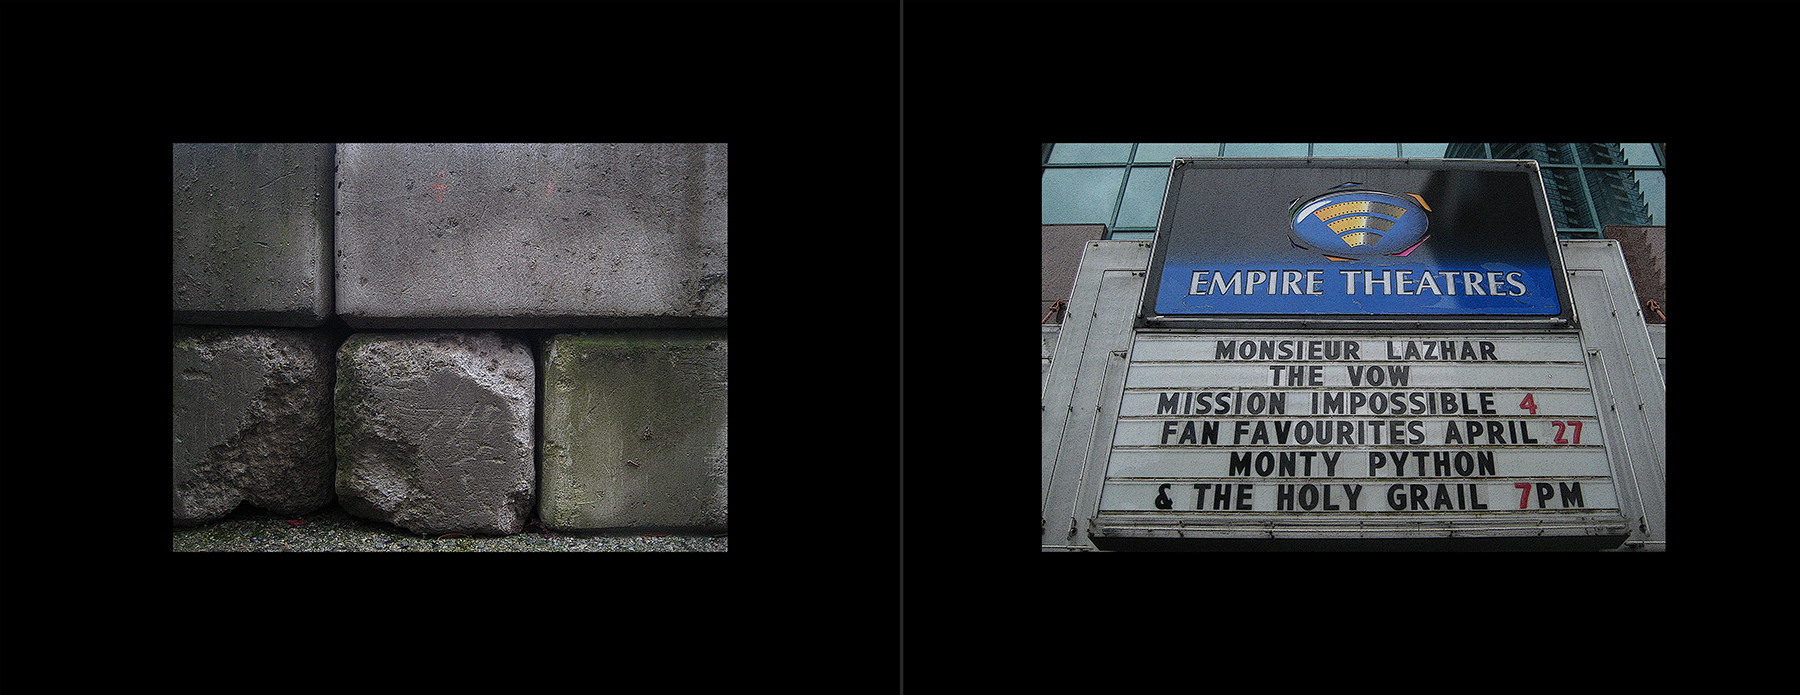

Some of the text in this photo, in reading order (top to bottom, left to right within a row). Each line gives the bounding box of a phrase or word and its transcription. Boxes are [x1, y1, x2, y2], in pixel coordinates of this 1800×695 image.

[1189, 270, 1527, 297] EMPIRE THEATRES
[1215, 341, 1497, 361] MONSIEUR LAZHAR
[1270, 366, 1410, 386] THE VOW
[1157, 392, 1538, 415] MISSION IMPOSSIBLE 4
[1161, 420, 1583, 445] FAN FAVOURITES APRIL 27
[1229, 451, 1496, 477] MONTY PYTHON
[1155, 482, 1584, 511] & THE HOLY GRAIL 7PM
